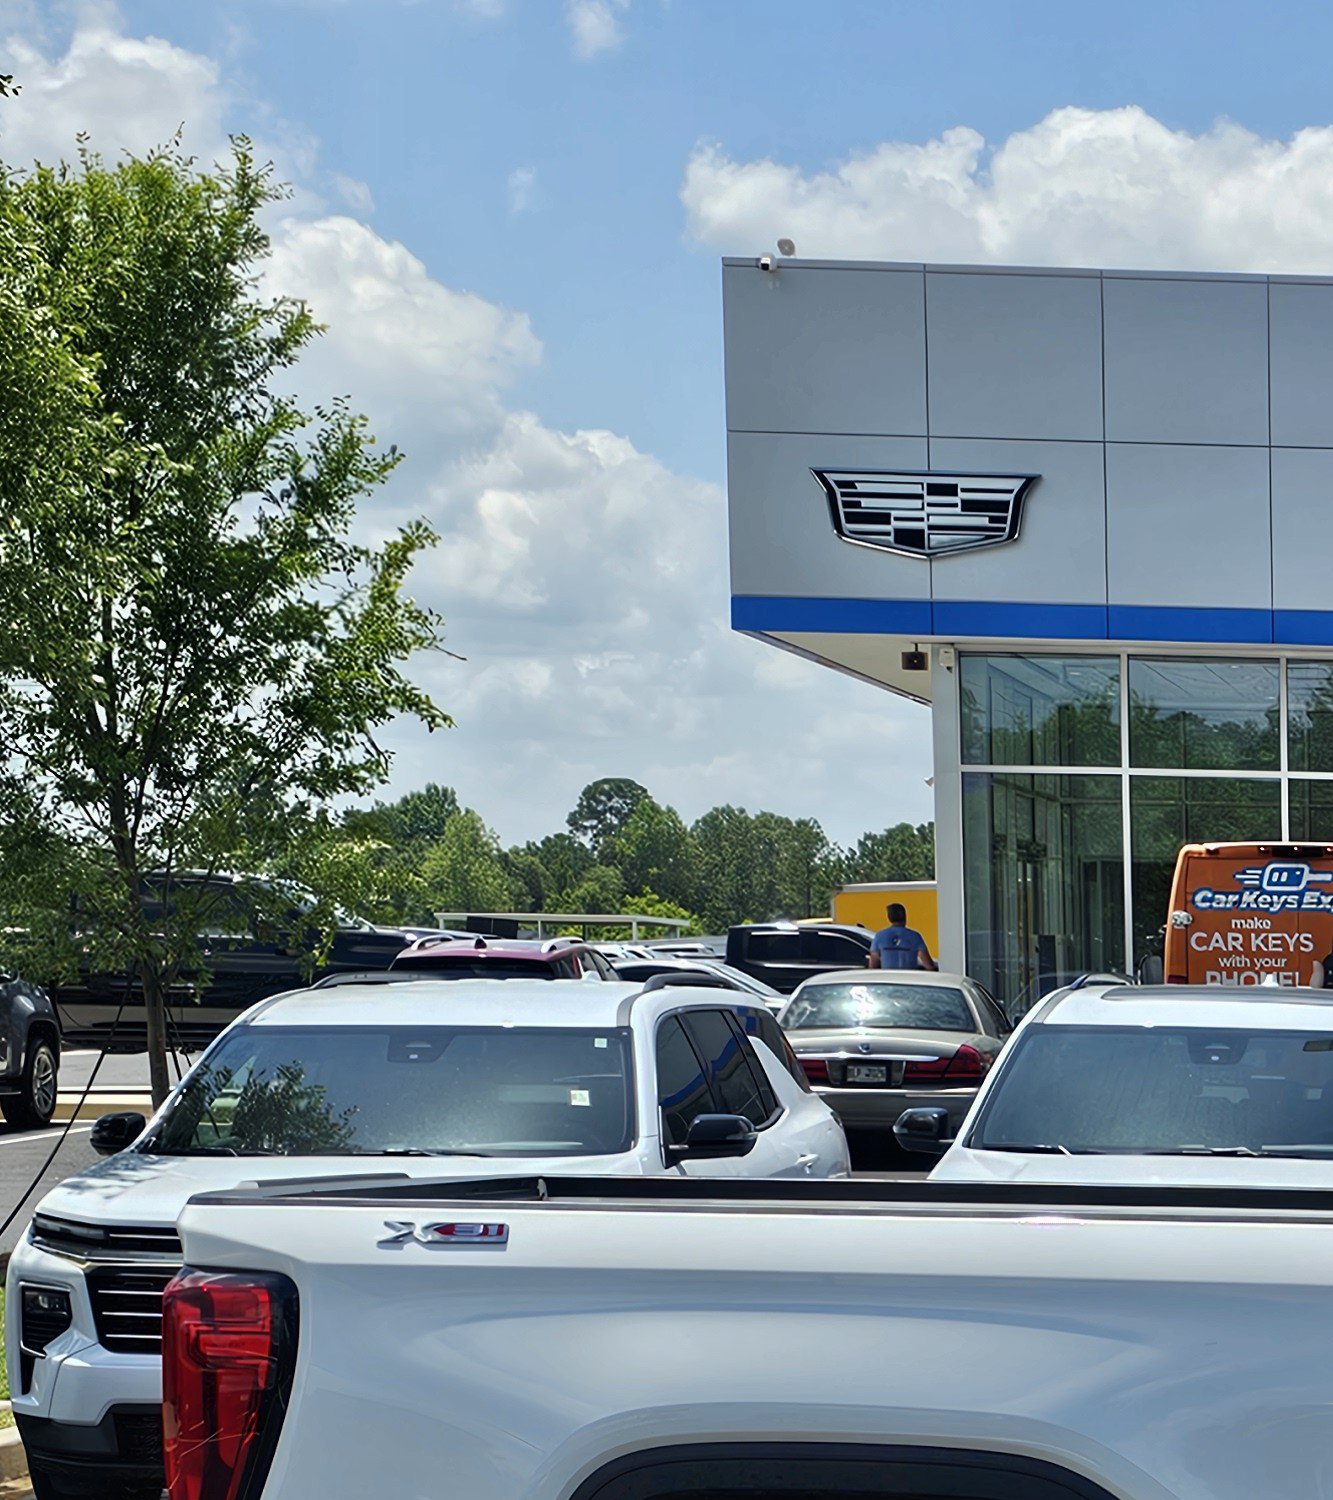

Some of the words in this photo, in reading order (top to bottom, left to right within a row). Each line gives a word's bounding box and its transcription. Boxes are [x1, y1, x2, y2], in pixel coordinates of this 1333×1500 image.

[1194, 890, 1239, 909] Car
[1240, 890, 1299, 912] Keys
[1190, 931, 1244, 951] CAR
[1251, 932, 1314, 952] KEYS
[1219, 954, 1250, 967] with
[1253, 957, 1287, 970] your
